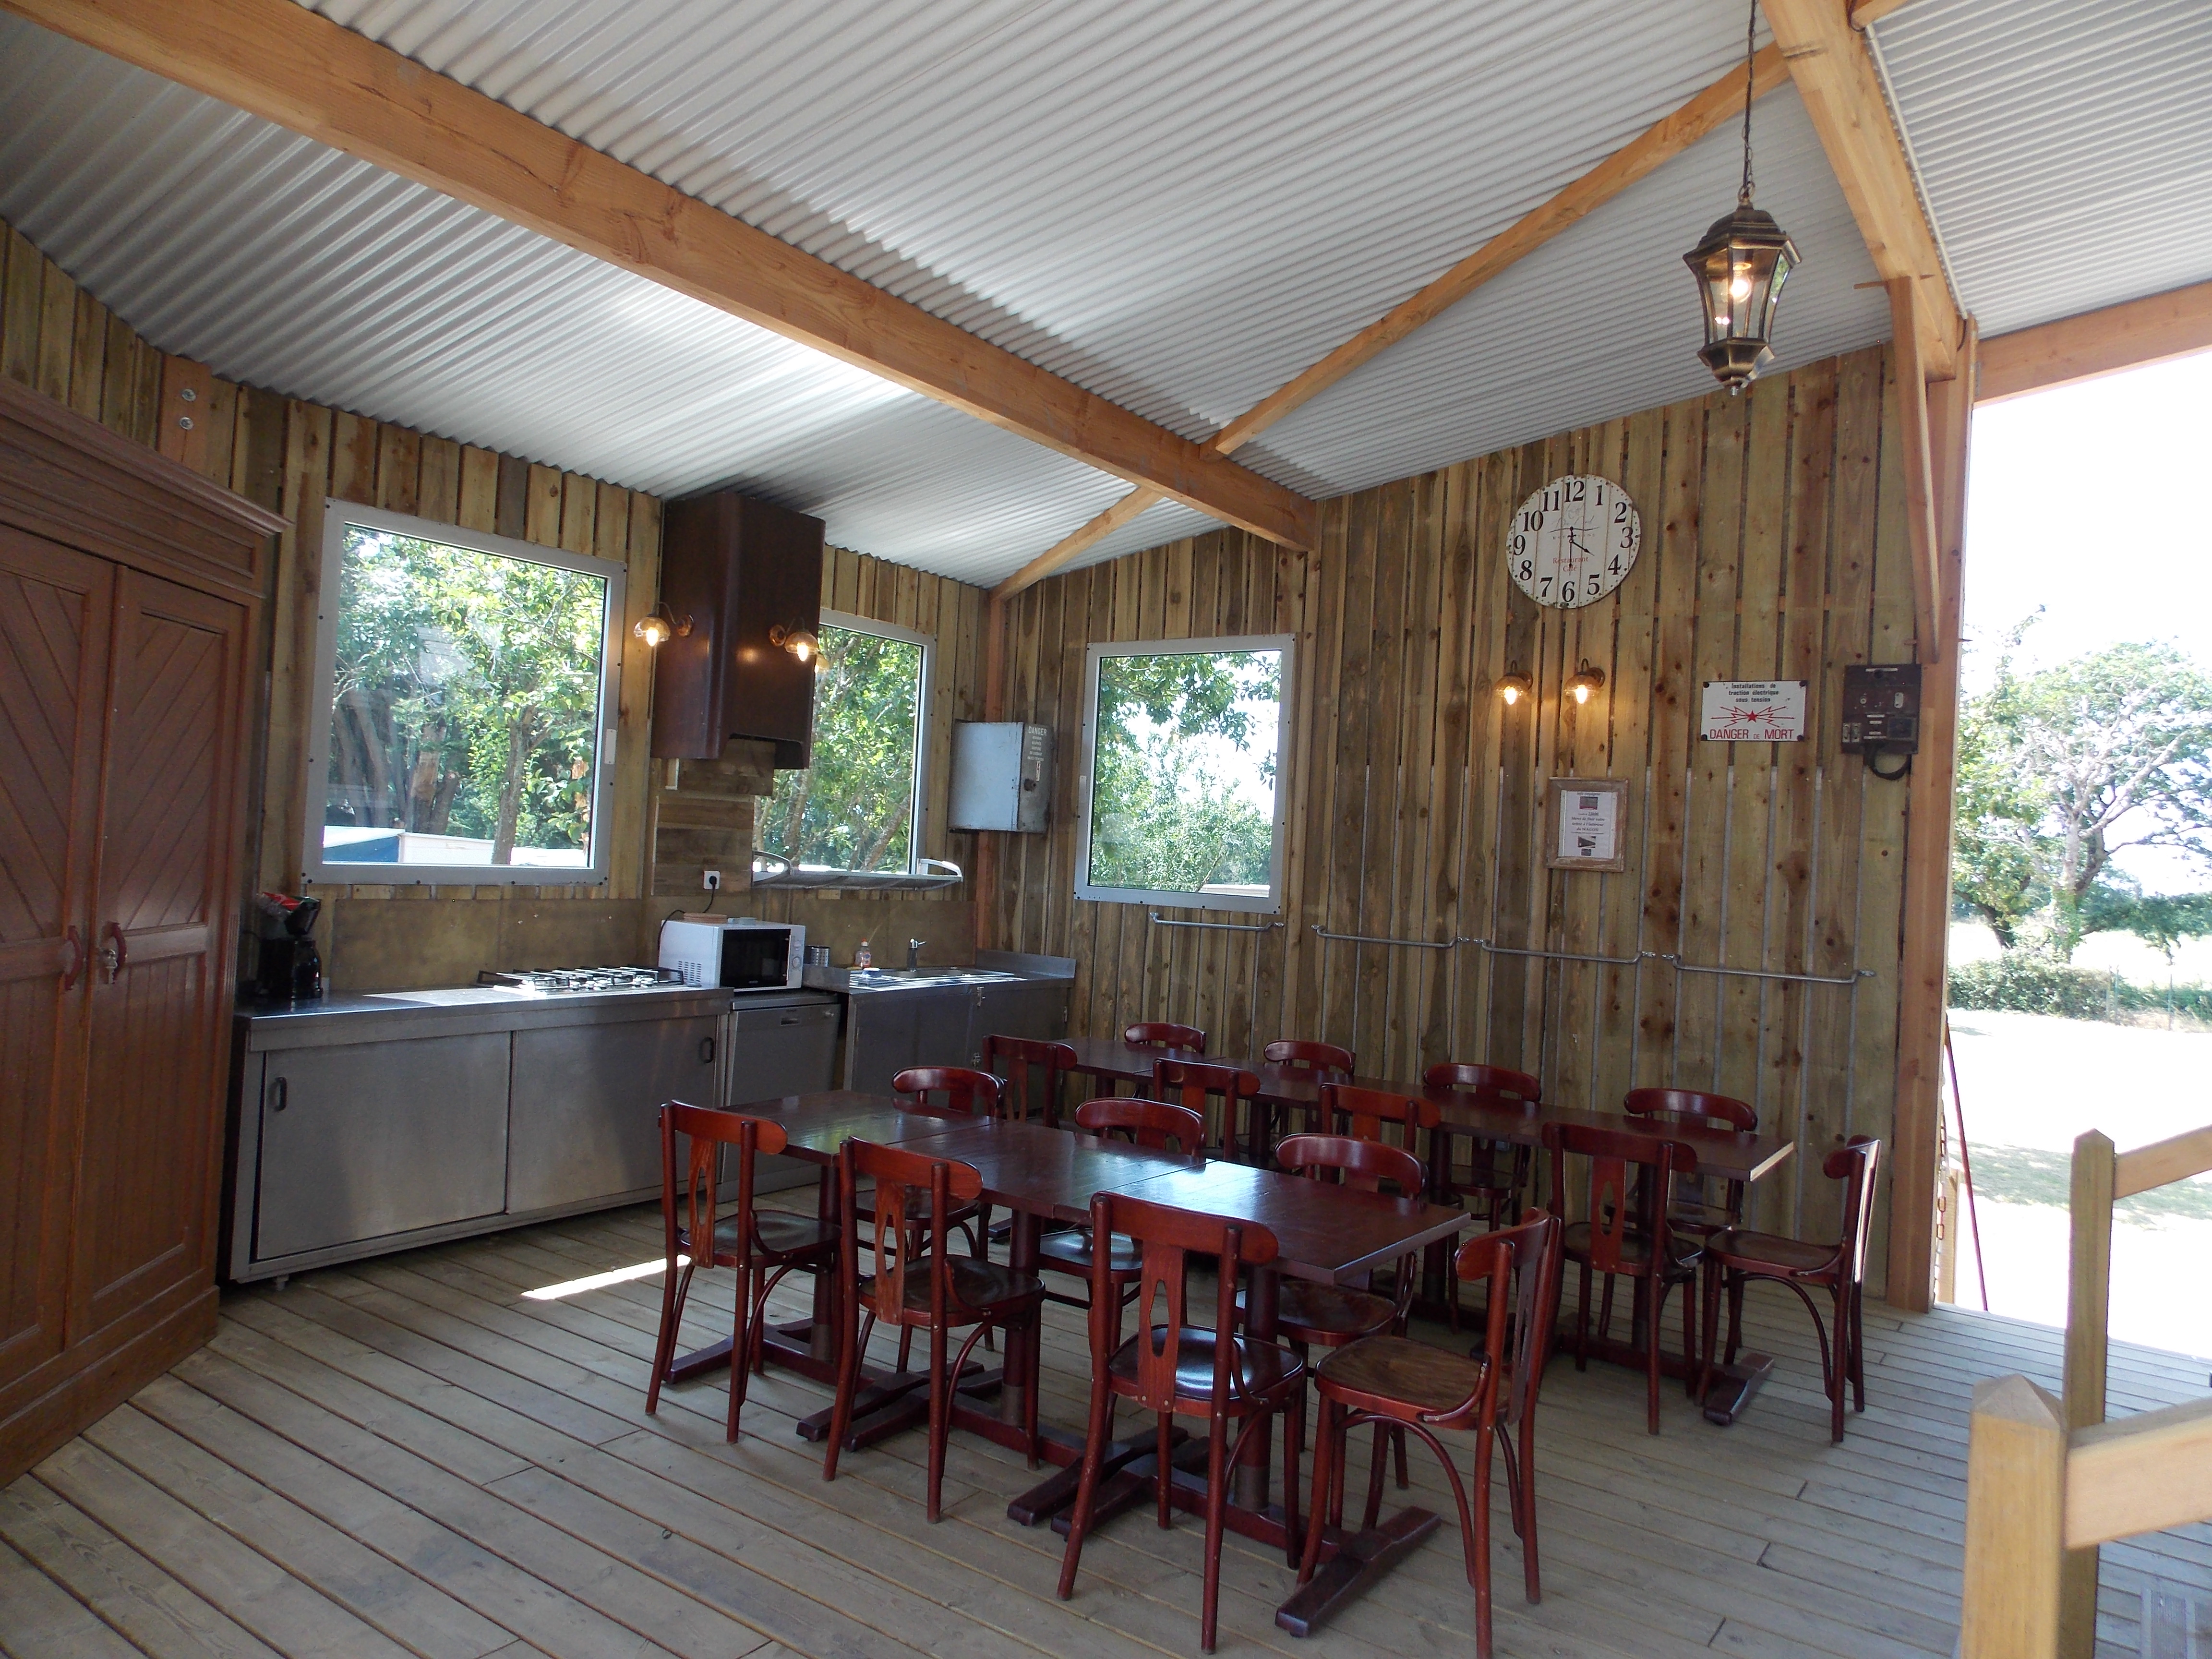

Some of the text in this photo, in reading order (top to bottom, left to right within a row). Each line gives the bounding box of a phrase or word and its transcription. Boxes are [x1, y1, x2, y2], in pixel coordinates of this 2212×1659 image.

[1542, 491, 1560, 512] 11
[1564, 481, 1584, 503] 12
[1596, 485, 1603, 505] 1
[1523, 510, 1543, 532] 10
[1614, 502, 1626, 523] 2
[1513, 535, 1526, 555] 9
[1620, 527, 1633, 548] 3
[1519, 560, 1532, 580] 8
[1608, 554, 1621, 575] 4
[1540, 577, 1553, 598] 7
[1562, 581, 1575, 602] 6
[1587, 574, 1599, 595] 5
[1028, 726, 1046, 736] DANGER
[1710, 729, 1749, 739] DANGER
[1765, 729, 1794, 739] MORT
